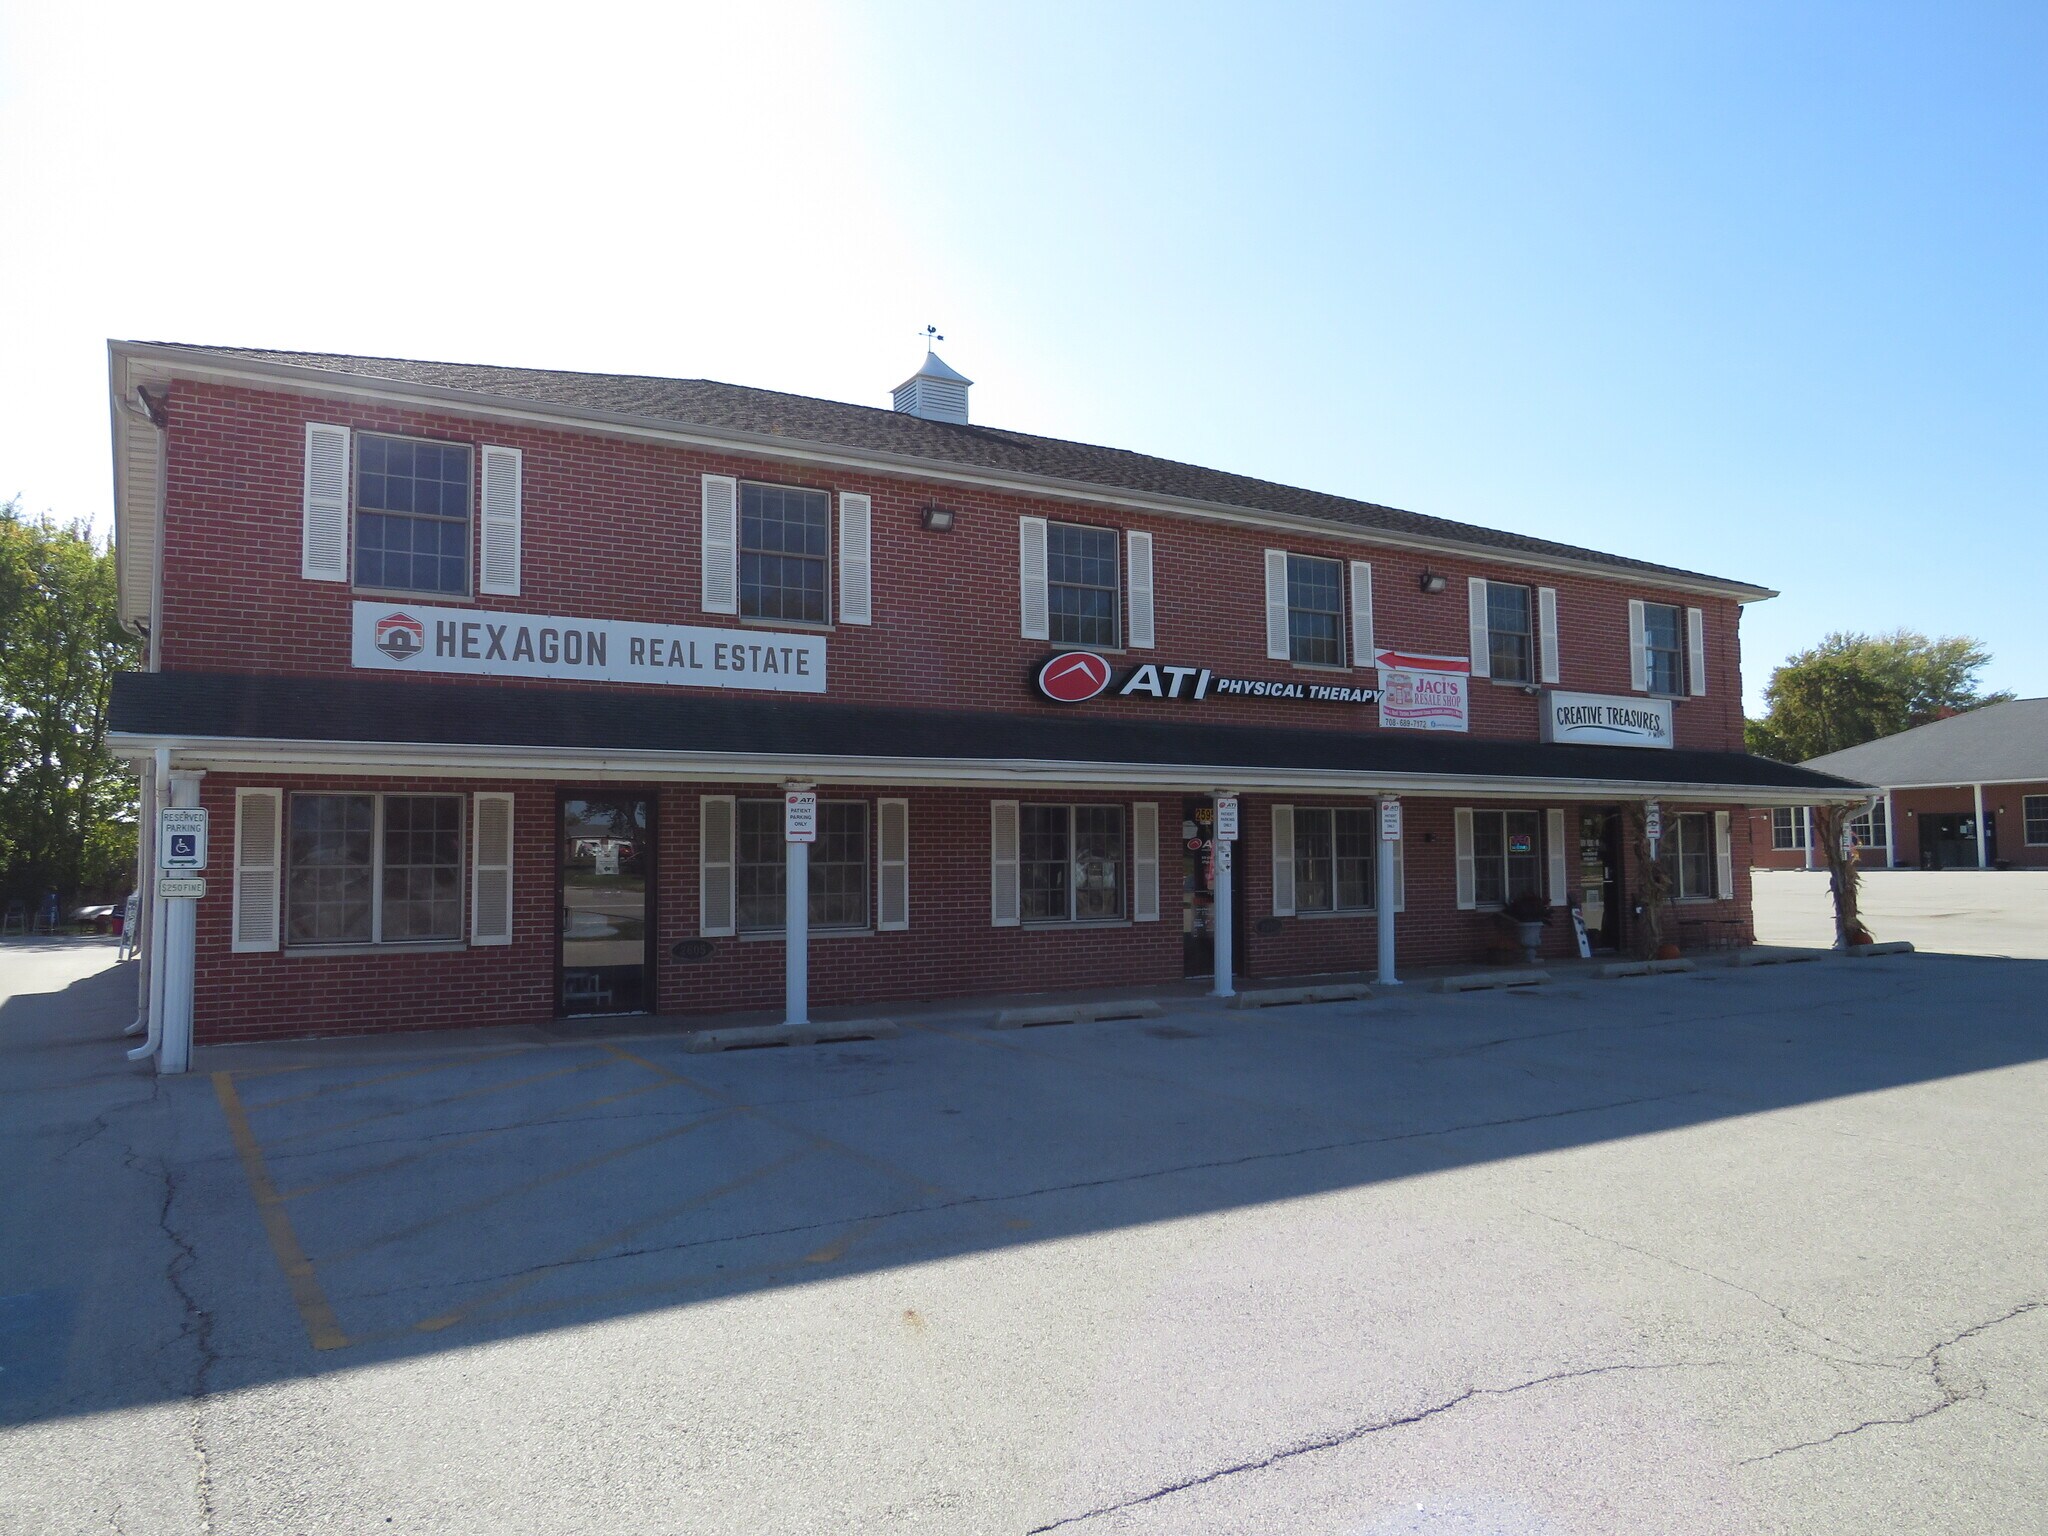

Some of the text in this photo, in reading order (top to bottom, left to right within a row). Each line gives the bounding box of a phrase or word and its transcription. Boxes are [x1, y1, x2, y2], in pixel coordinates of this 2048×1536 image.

[436, 620, 810, 676] HEXAGON REAL ESTATE
[1119, 664, 1384, 703] ATI PHYSICAL THERAPY
[1414, 692, 1461, 708] RESALE SHOP
[1556, 706, 1660, 731] CREATIVE TREASURES
[163, 813, 205, 823] RESERVED
[165, 824, 202, 833] PARKING
[161, 882, 202, 893] $250 FINE
